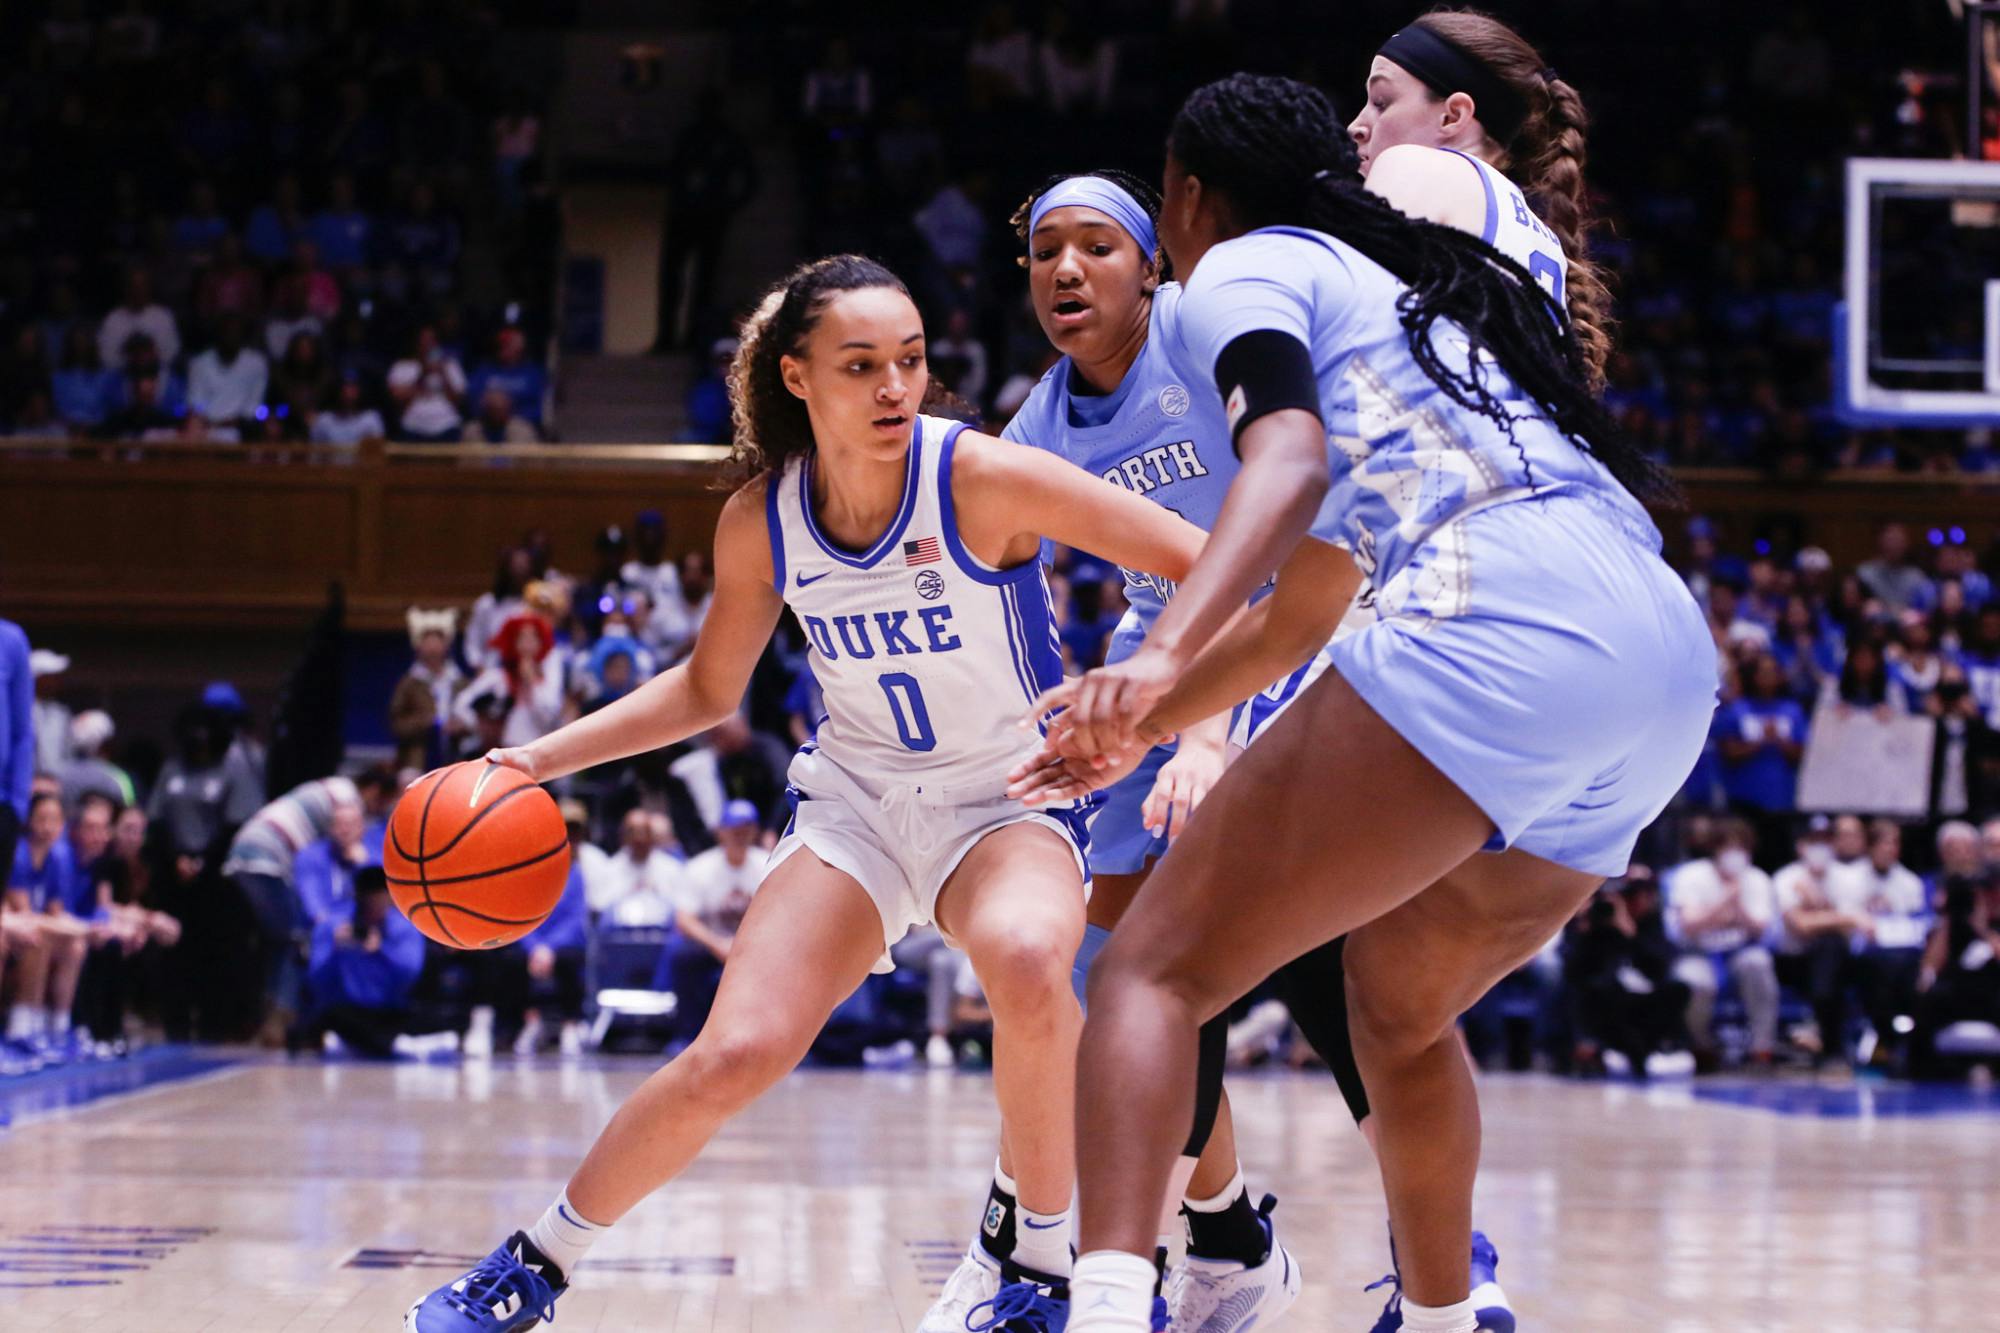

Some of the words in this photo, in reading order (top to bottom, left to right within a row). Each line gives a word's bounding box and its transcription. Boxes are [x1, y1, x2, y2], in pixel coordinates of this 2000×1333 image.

[1102, 440, 1209, 495] ORTH
[804, 605, 962, 661] DUKE
[878, 672, 937, 752] 0
